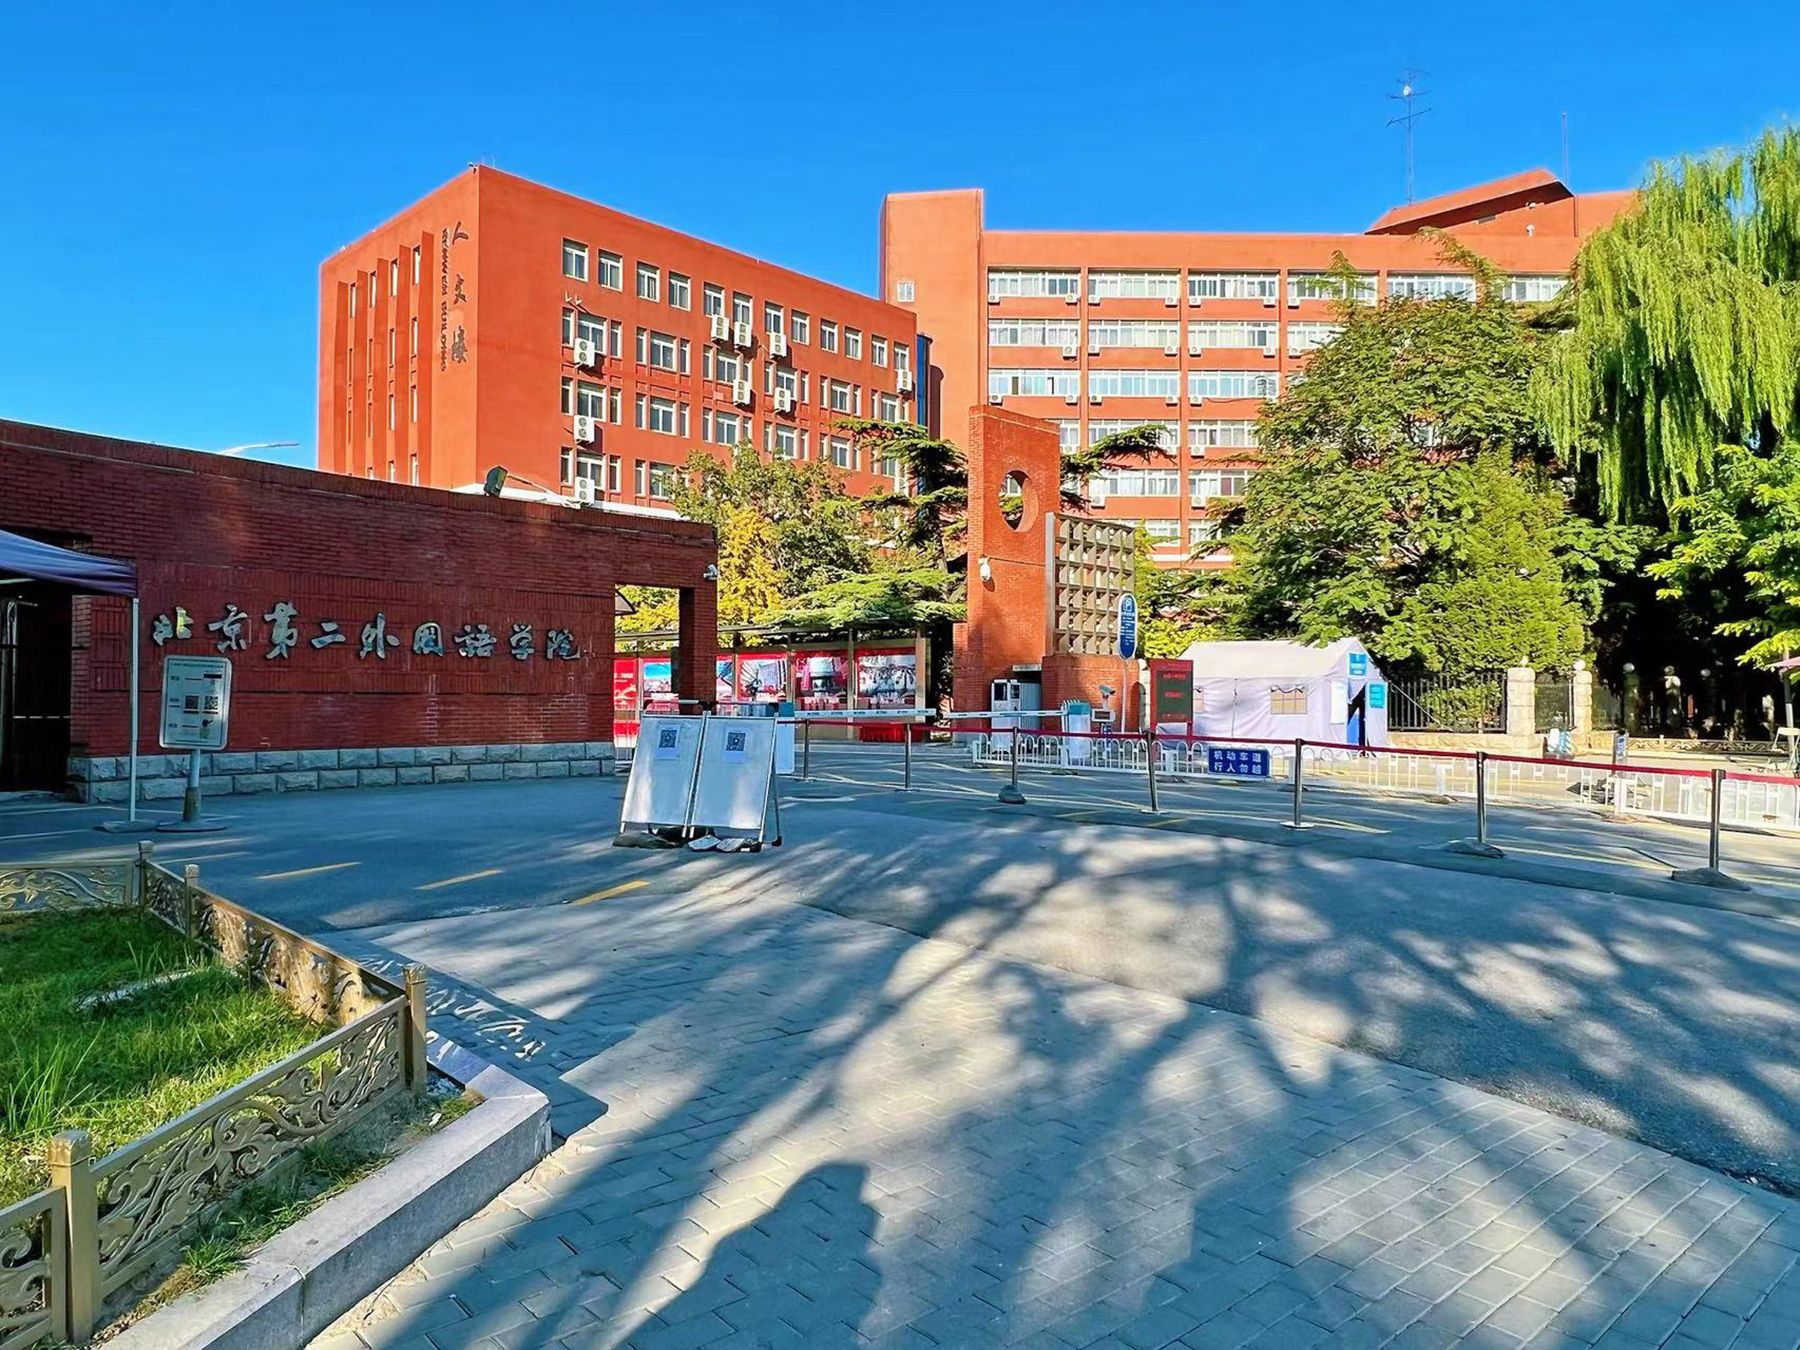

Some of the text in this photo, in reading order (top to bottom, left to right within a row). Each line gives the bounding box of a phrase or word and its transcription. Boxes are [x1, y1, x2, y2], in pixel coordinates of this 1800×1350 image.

[1213, 750, 1262, 763] 机动车道
[1213, 761, 1262, 775] 行人勿越
